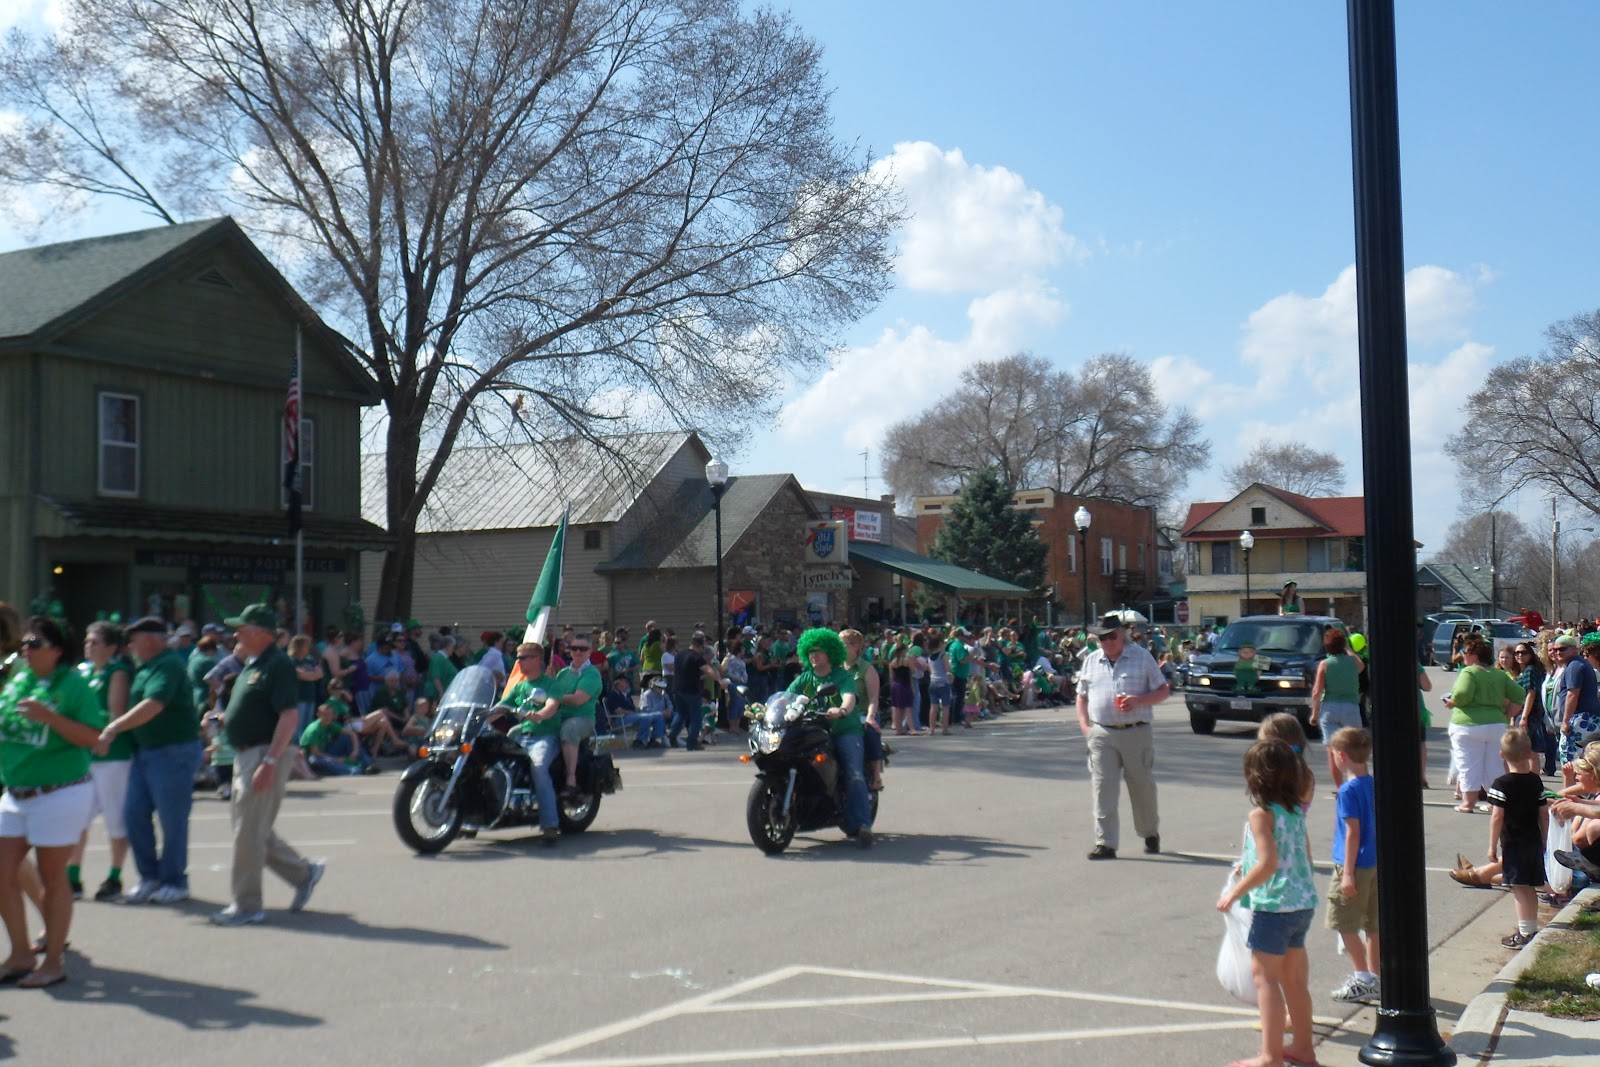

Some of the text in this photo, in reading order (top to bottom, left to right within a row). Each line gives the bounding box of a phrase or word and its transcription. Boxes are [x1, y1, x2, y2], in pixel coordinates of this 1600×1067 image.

[817, 532, 830, 543] Old
[815, 541, 833, 556] Style
[256, 557, 287, 570] POST
